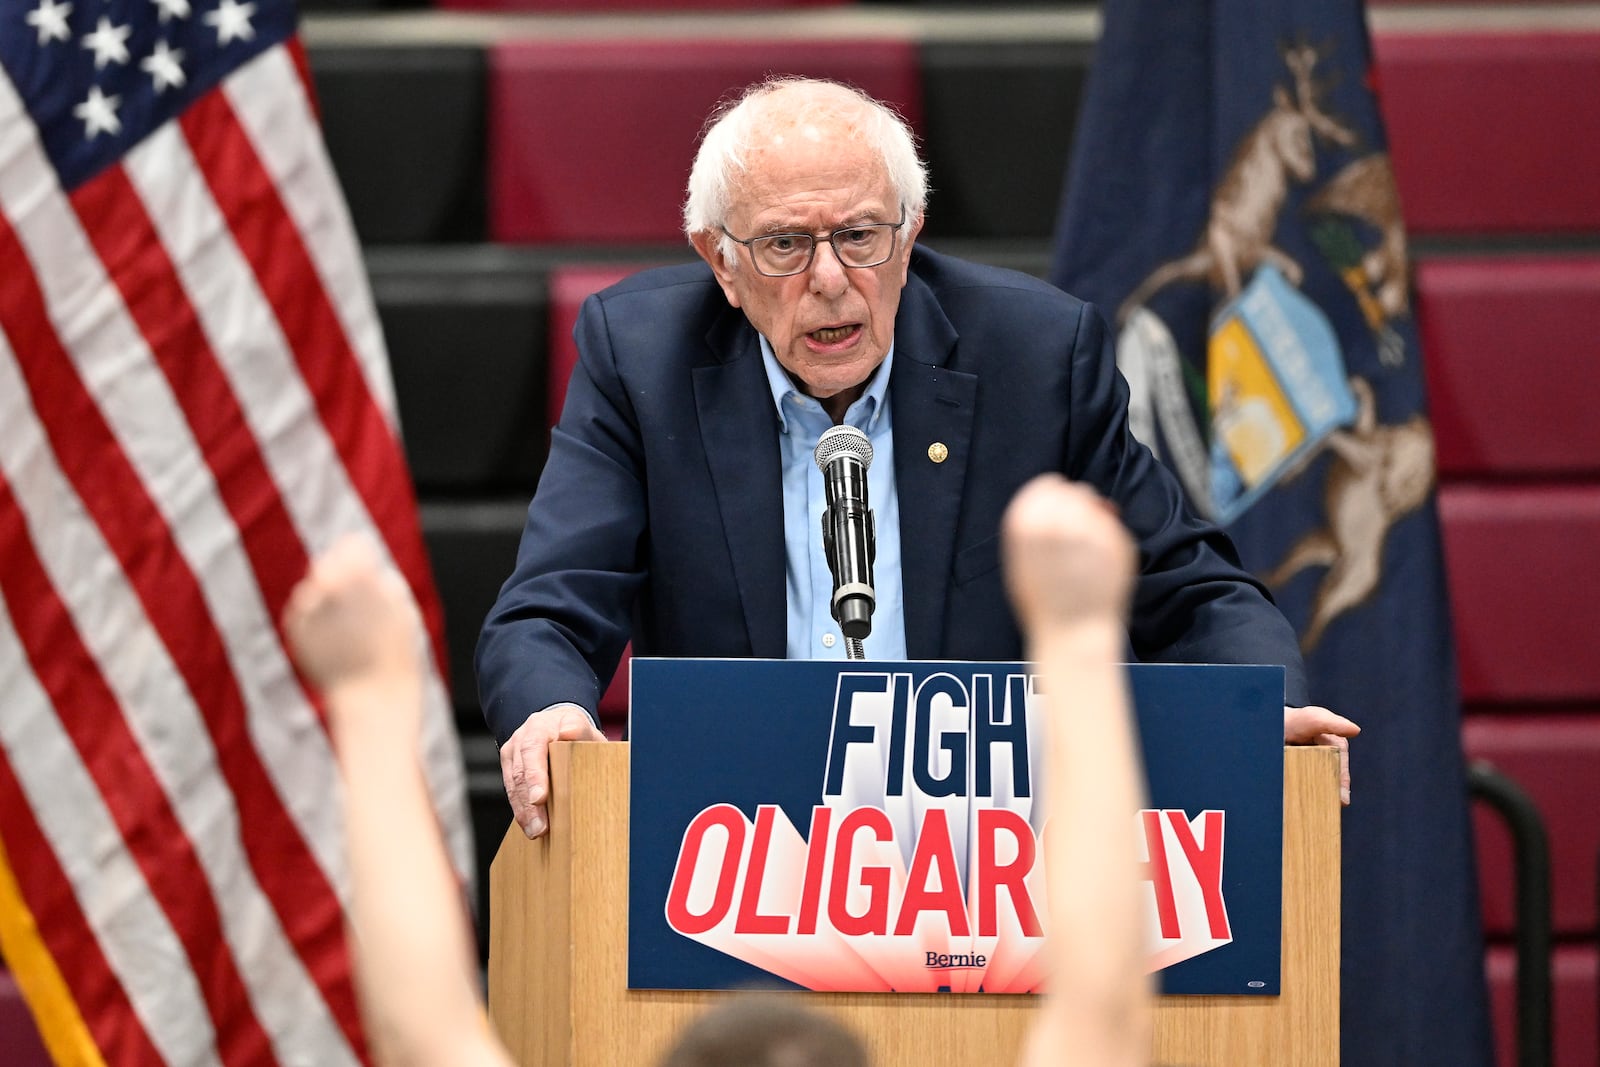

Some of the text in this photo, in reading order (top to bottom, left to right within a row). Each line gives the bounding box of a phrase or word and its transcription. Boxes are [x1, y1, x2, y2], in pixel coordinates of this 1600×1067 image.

[823, 672, 1048, 799] FIGH
[666, 803, 1232, 941] OLIGARHY
[925, 951, 986, 968] Bernie
